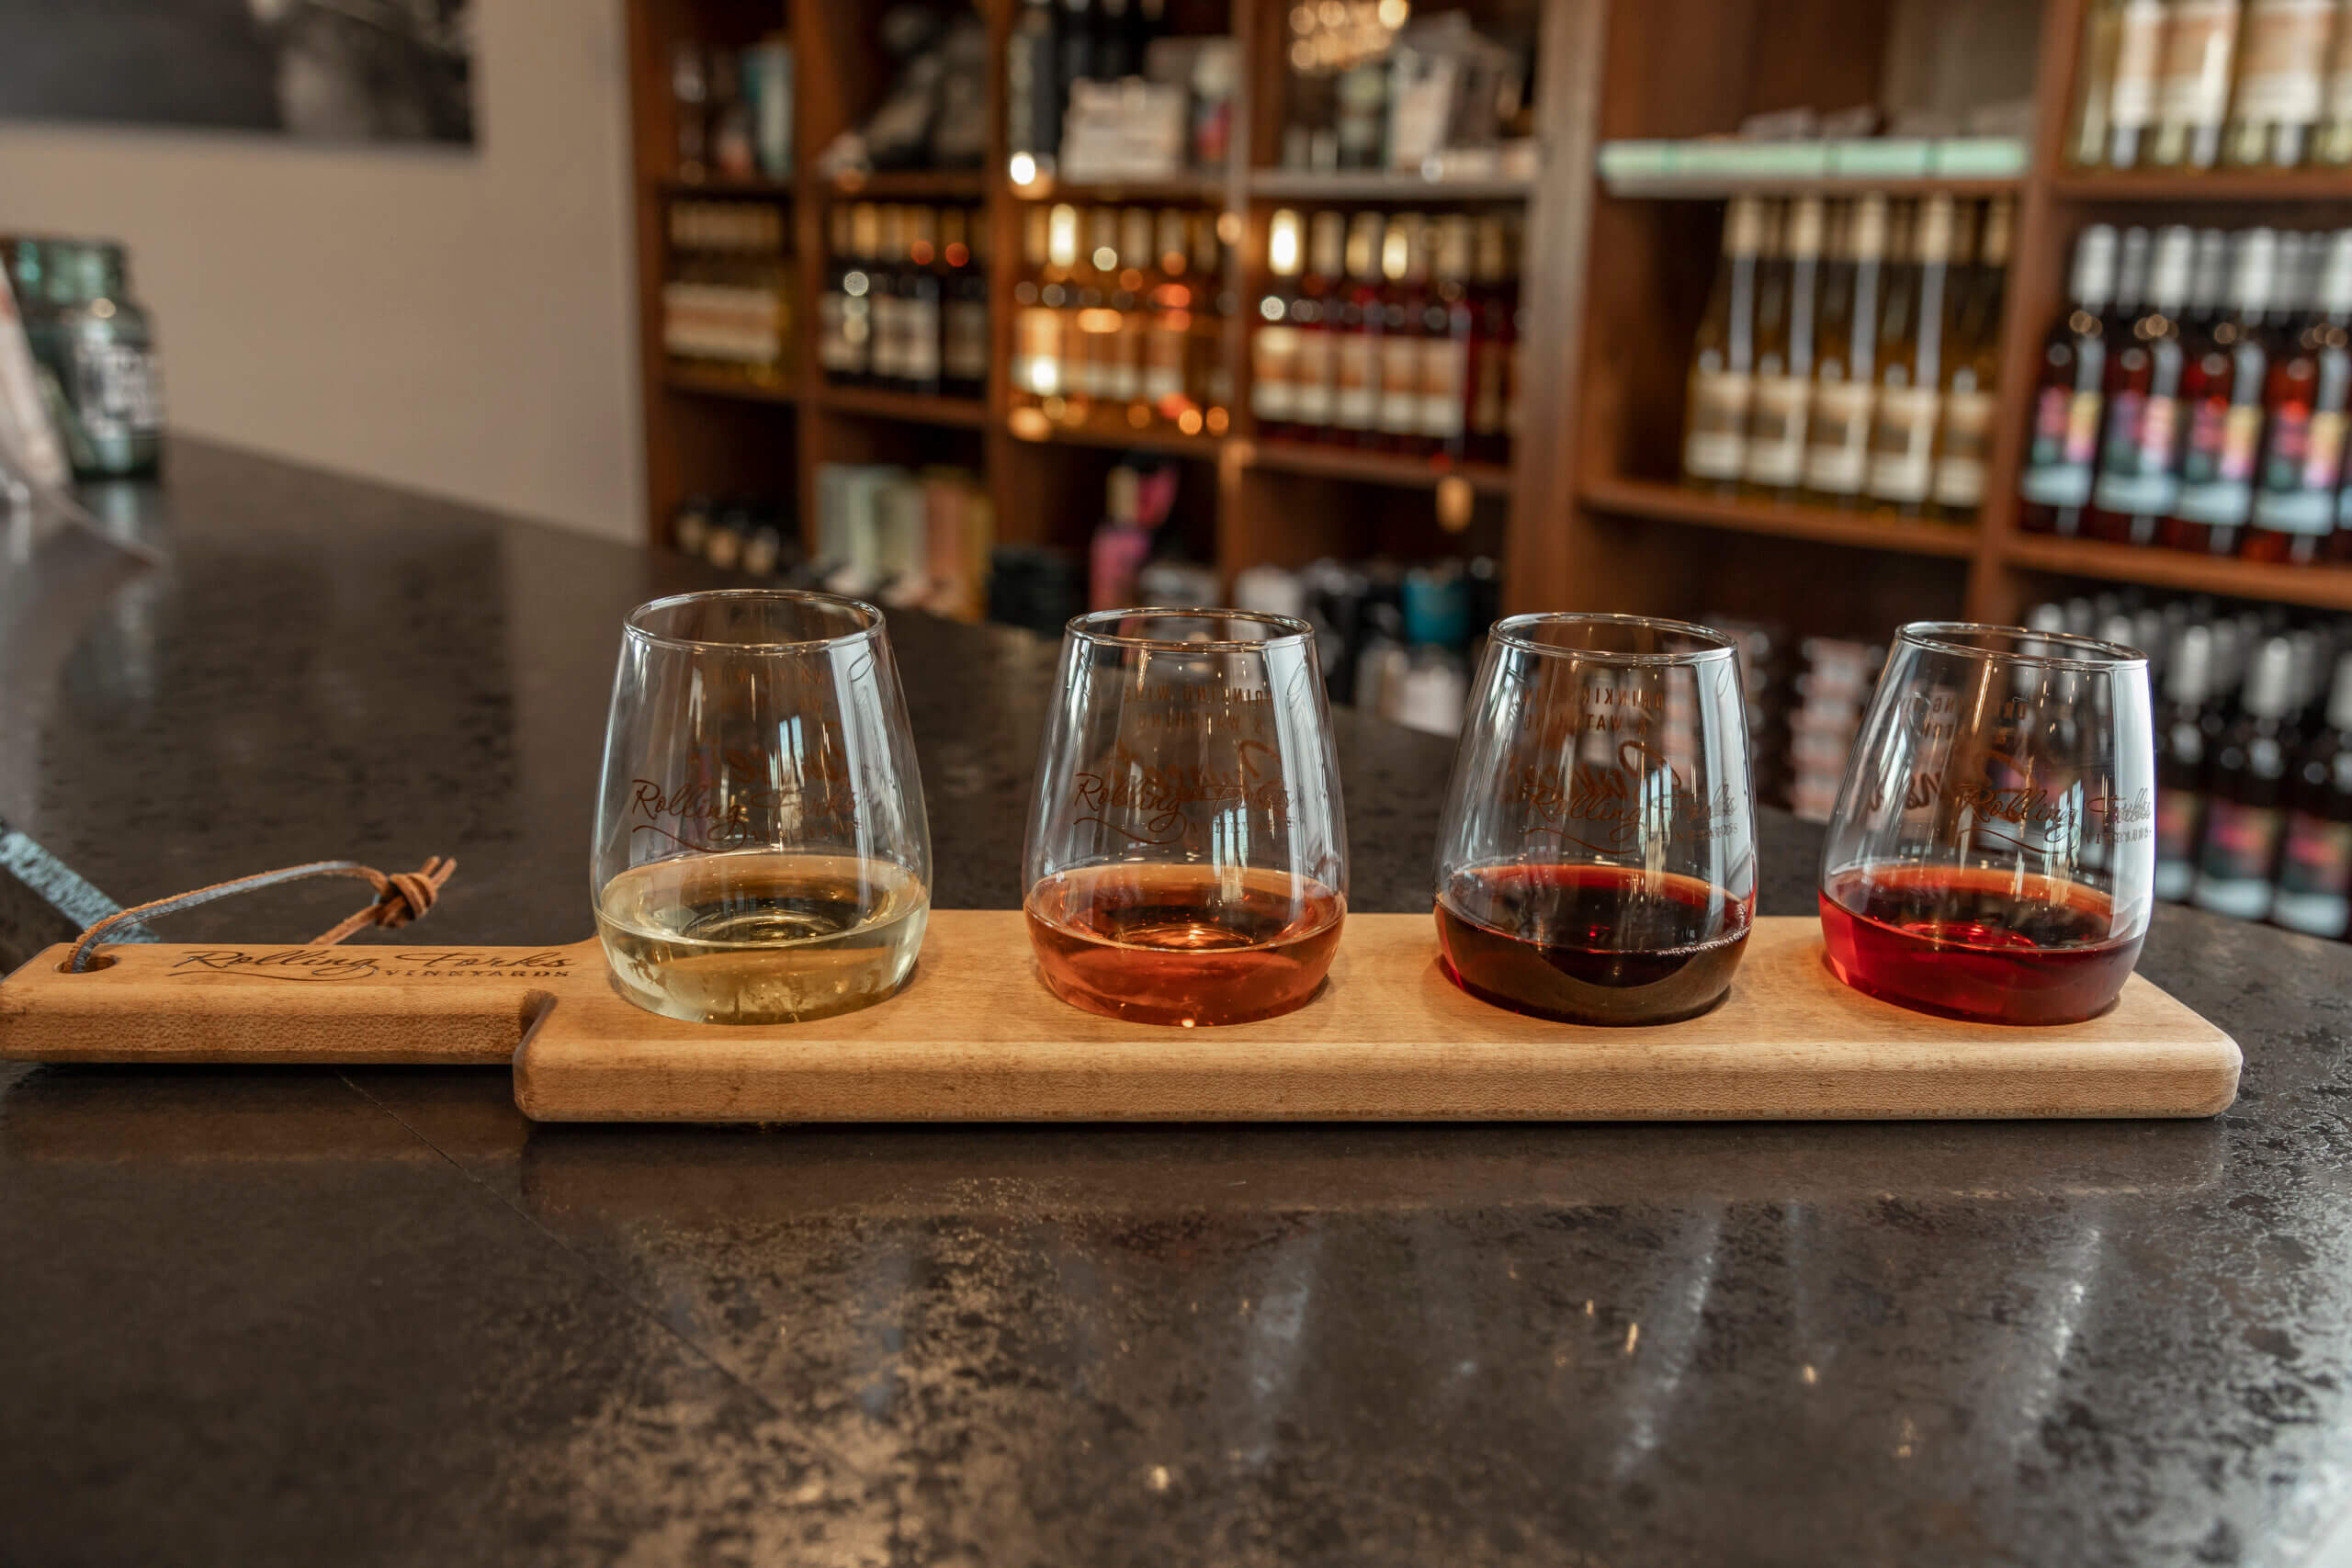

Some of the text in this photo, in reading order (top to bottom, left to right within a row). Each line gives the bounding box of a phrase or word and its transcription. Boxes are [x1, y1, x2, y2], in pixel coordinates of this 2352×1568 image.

[632, 779, 747, 852] Rolling
[1073, 772, 1186, 844] Rolling
[1524, 784, 1645, 854] Rolling
[1956, 784, 2082, 854] Rolling
[166, 950, 578, 982] Rolling Forks
[386, 969, 570, 978] VINEYARDS
